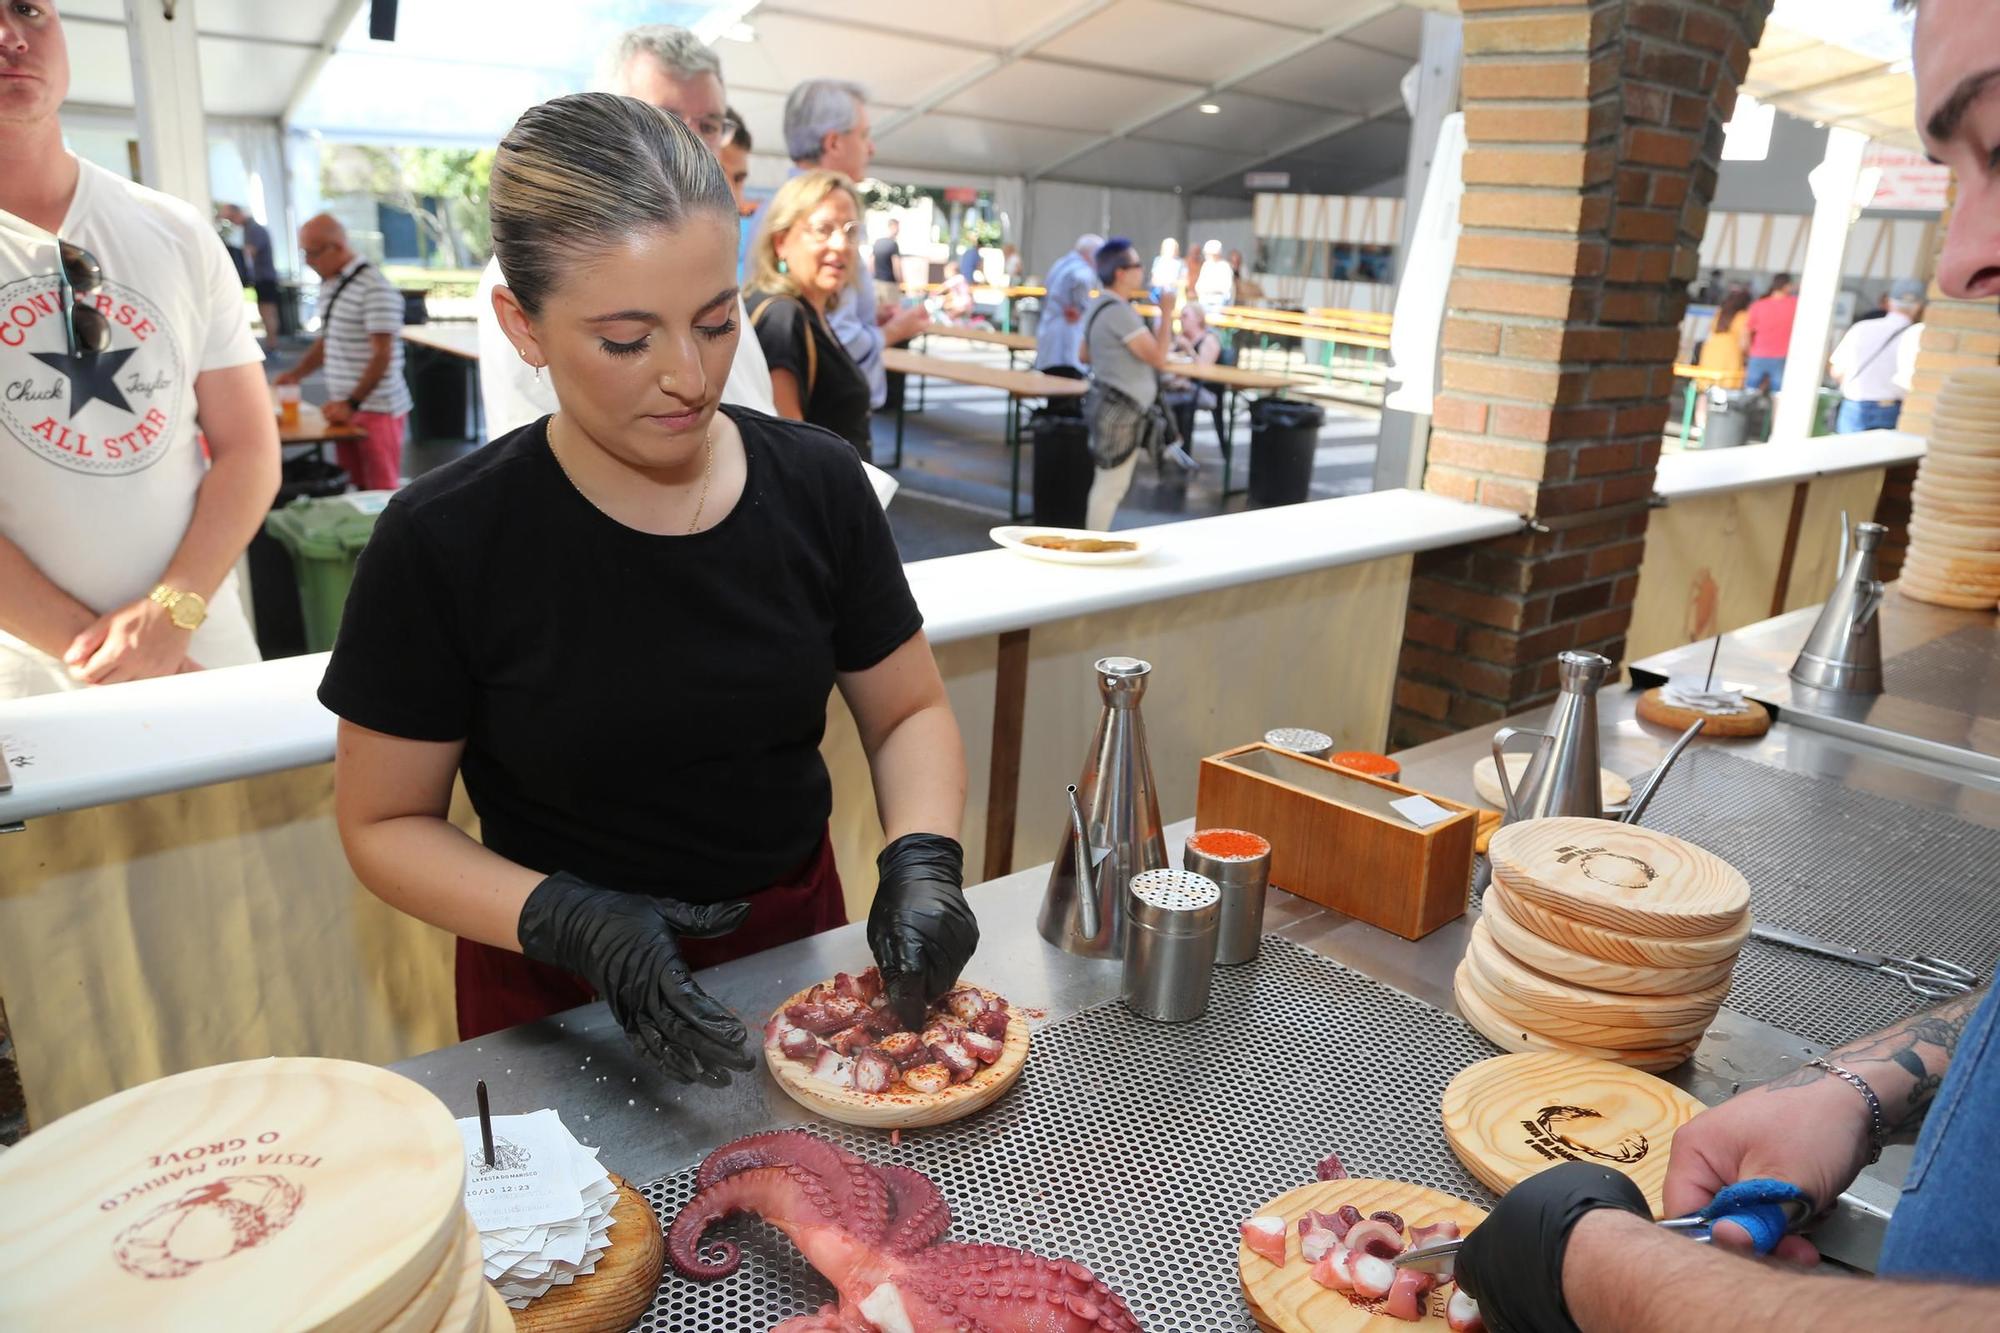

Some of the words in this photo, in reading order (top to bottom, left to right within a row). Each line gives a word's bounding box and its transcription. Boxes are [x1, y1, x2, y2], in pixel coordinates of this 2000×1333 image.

[6, 377, 65, 402] Chuck
[32, 415, 94, 457] ALL
[104, 407, 167, 459] STAR
[256, 1131, 281, 1144] O
[149, 1139, 247, 1167] GROVE
[217, 1155, 246, 1168] do
[255, 1152, 323, 1168] FESTA
[99, 1163, 207, 1212] MARISCO
[501, 1184, 530, 1193] 12:23
[1432, 1289, 1445, 1318] FESTA
